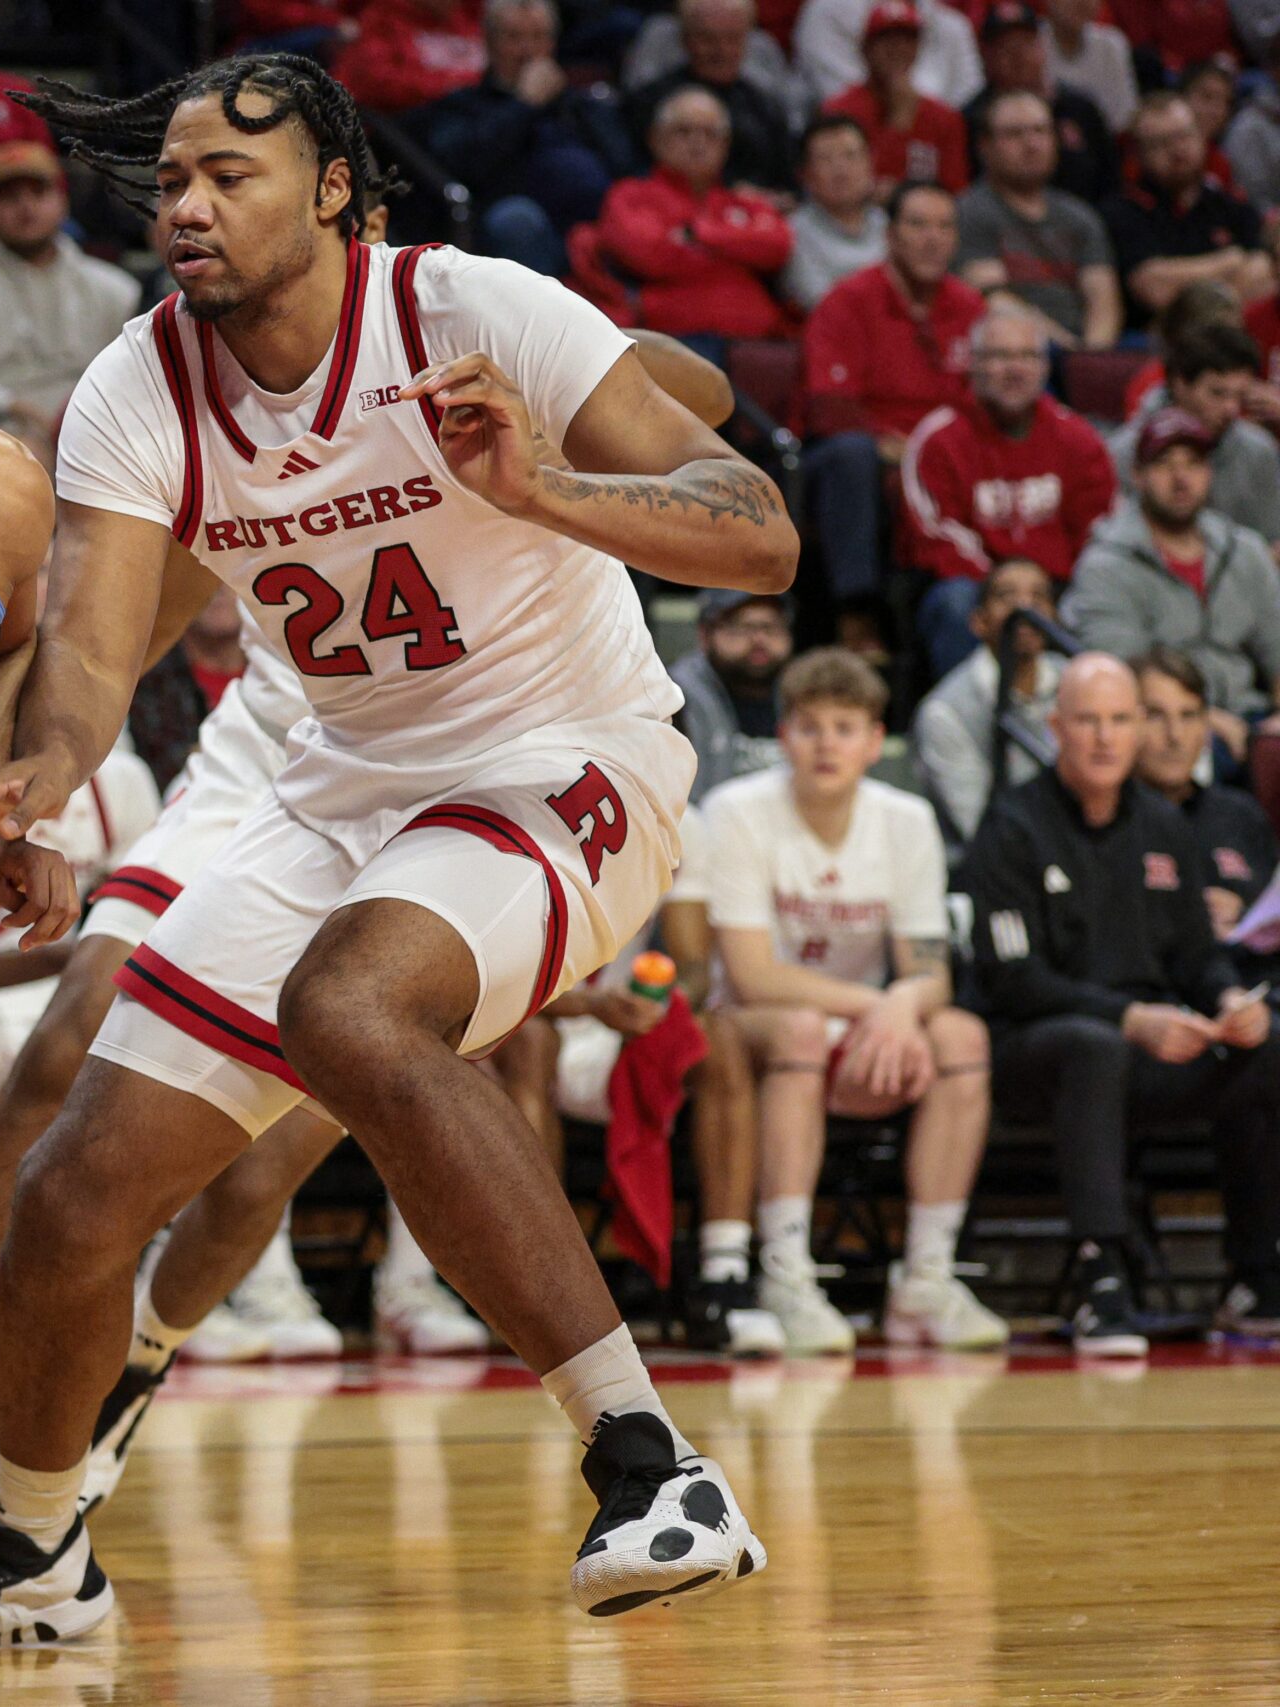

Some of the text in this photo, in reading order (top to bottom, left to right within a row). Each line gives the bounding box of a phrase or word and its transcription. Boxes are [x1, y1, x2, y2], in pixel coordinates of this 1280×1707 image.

[204, 474, 443, 552] RUTGERS
[251, 541, 467, 677] 24
[544, 760, 628, 888] R
